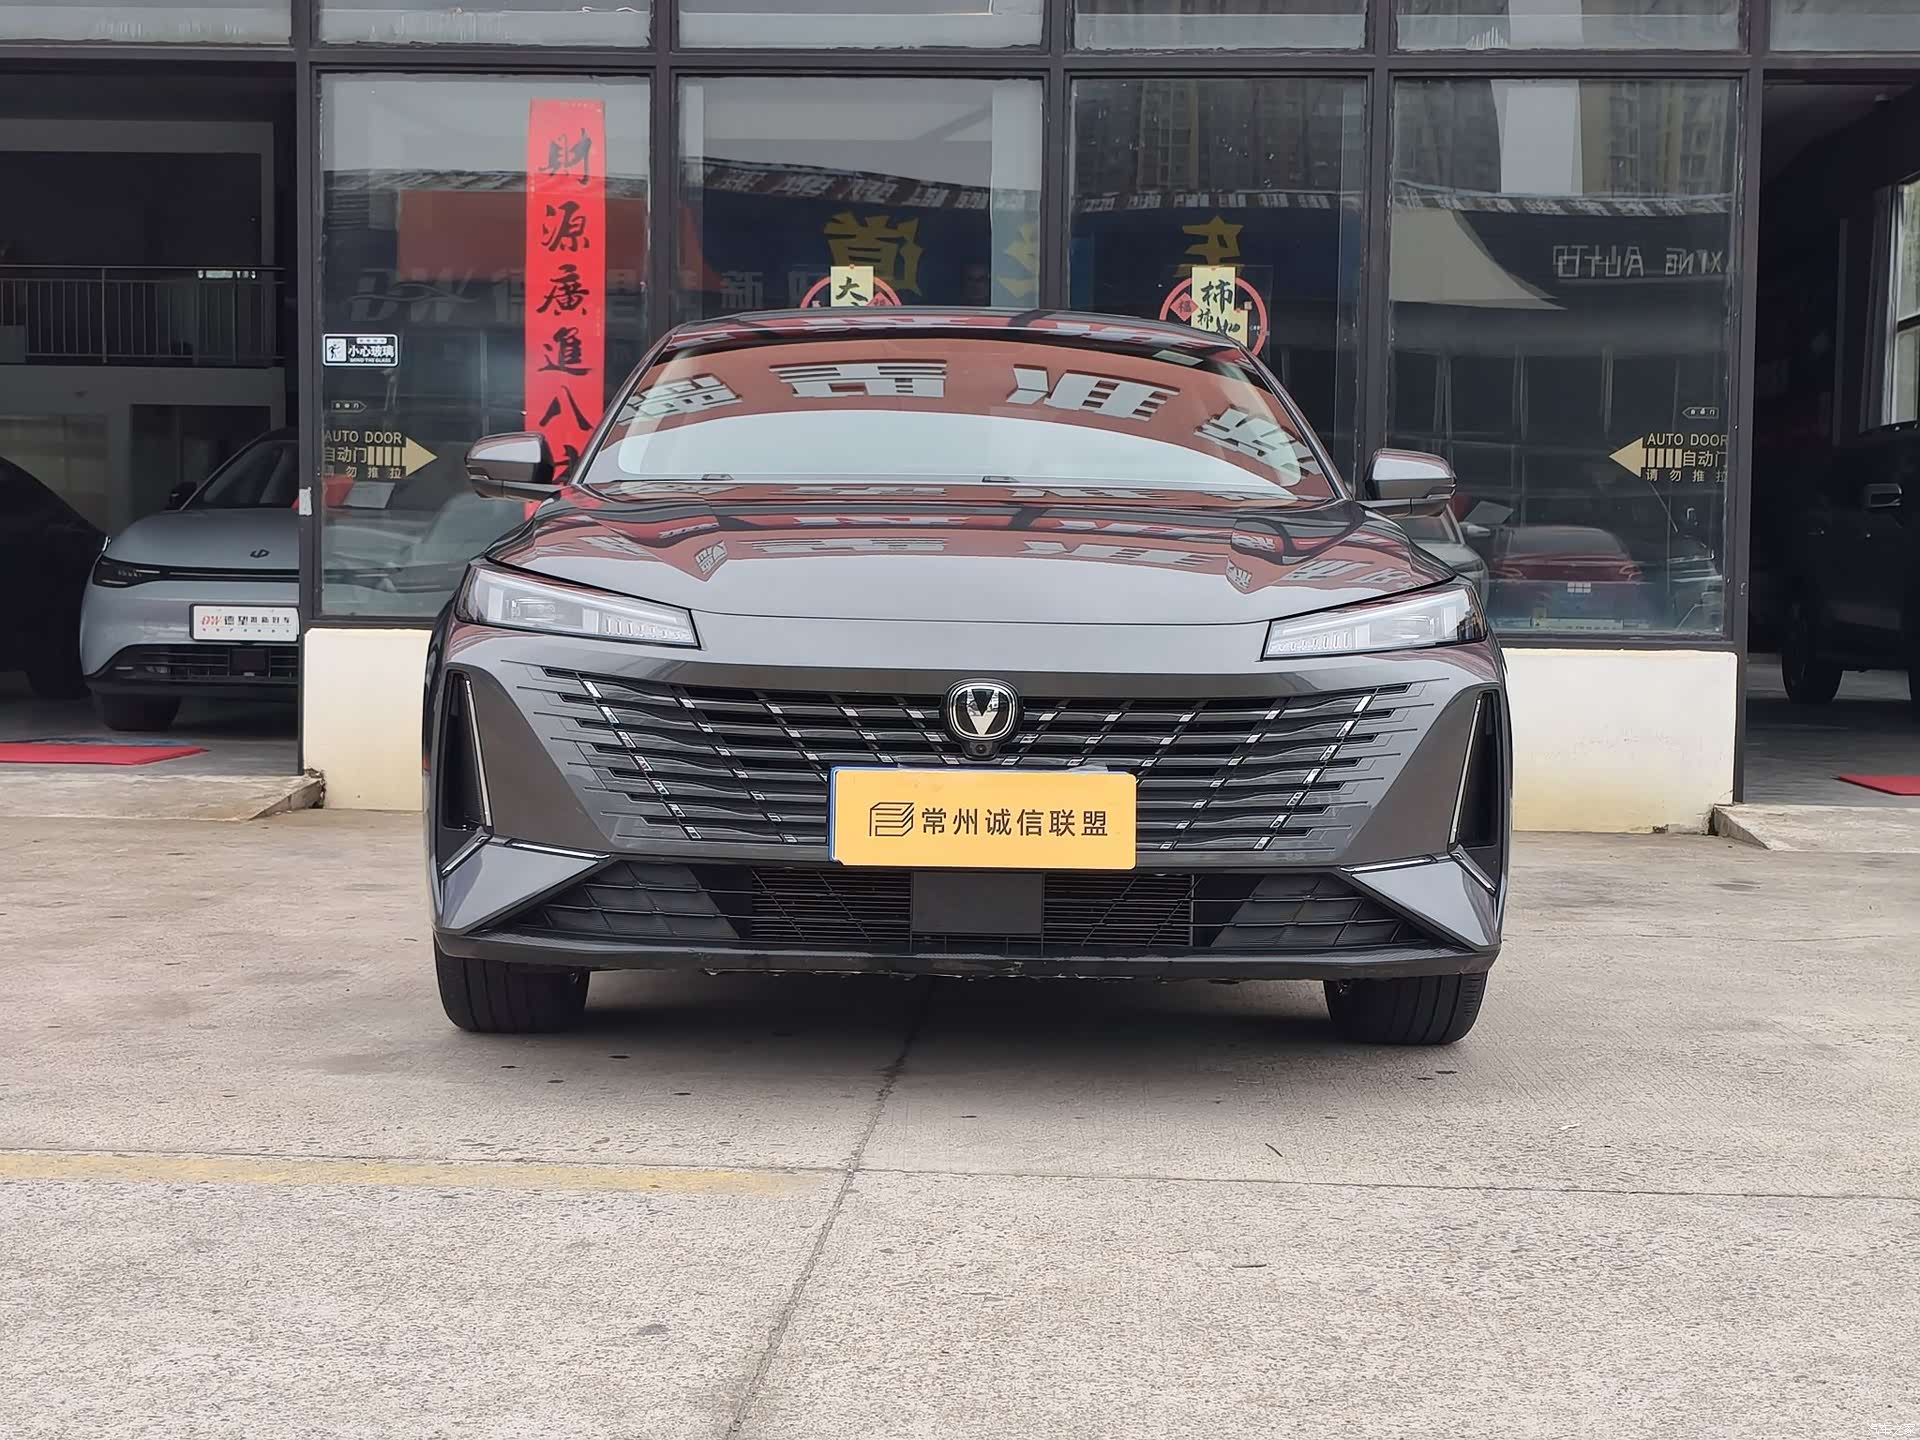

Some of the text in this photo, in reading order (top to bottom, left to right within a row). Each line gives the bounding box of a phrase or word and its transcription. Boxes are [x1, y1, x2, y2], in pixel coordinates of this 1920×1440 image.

[836, 276, 868, 306] 大
[348, 345, 394, 357] 小心玻璃
[324, 430, 402, 443] AUTO DOOR
[1647, 433, 1728, 446] AUTO DOOR
[323, 446, 367, 463] 自动门
[921, 807, 1108, 837] 常州诚信联盟
